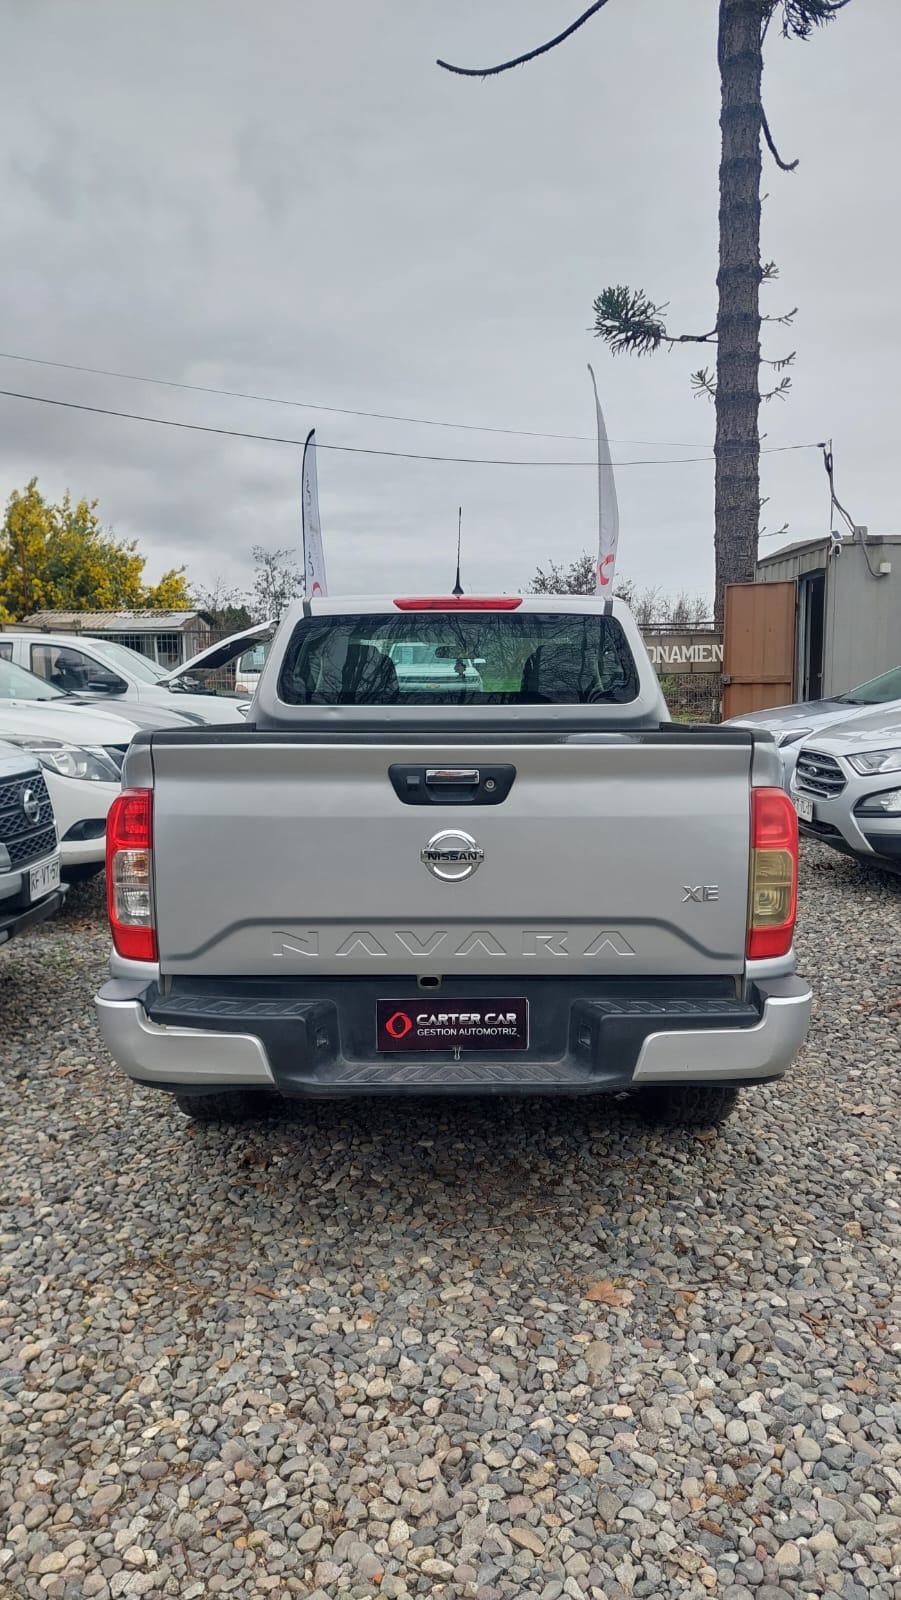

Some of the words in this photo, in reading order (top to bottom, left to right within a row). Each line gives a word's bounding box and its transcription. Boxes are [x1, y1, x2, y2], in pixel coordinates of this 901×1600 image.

[427, 851, 478, 861] NISSAN
[681, 885, 719, 903] XE
[271, 931, 636, 956] NAVARA
[416, 1013, 481, 1026] CARTER
[484, 1013, 517, 1025] CAR
[416, 1028, 457, 1037] GESTION
[459, 1027, 518, 1036] AUTOMOTRIZ
